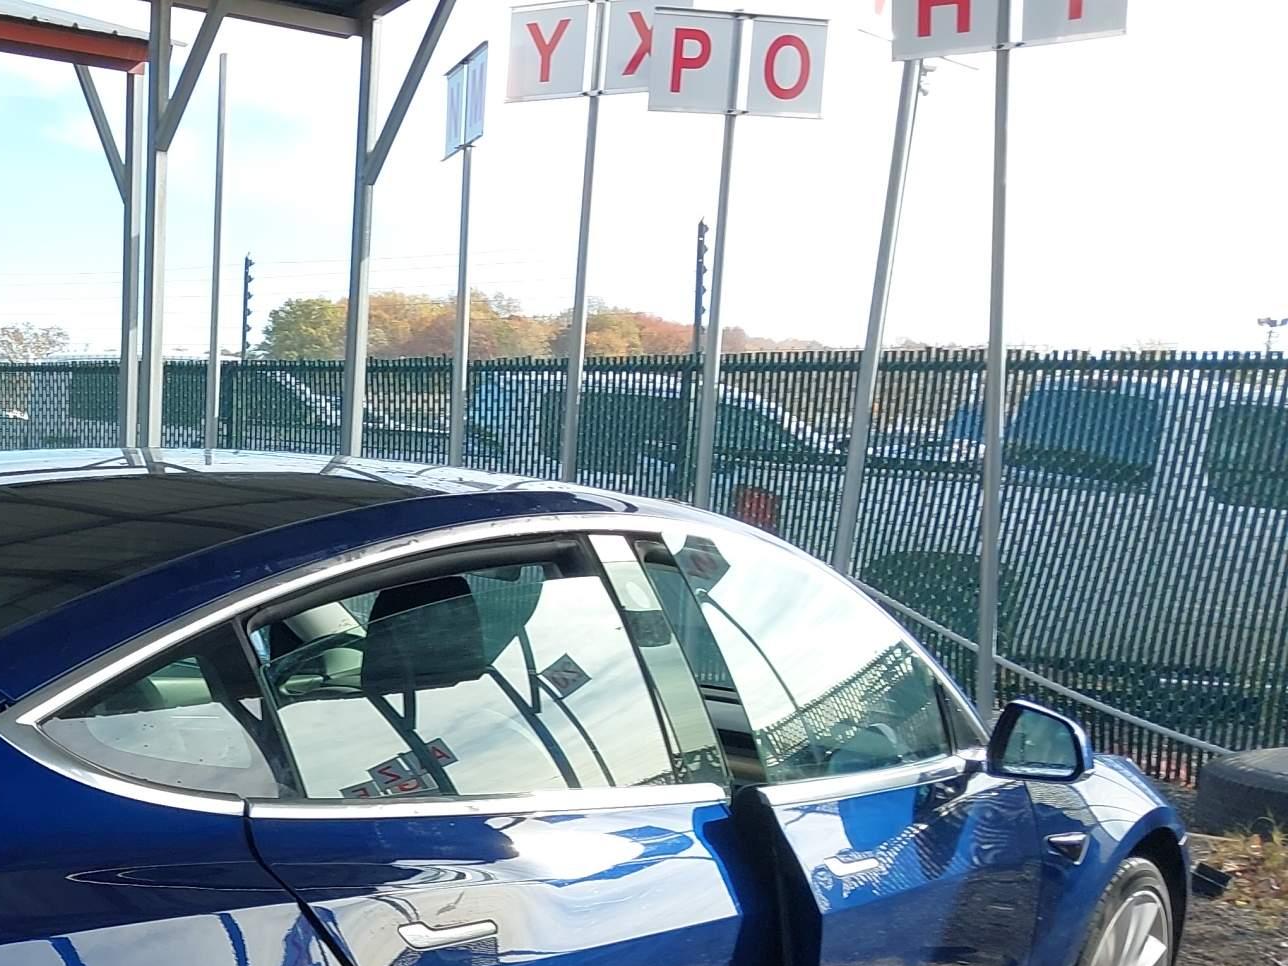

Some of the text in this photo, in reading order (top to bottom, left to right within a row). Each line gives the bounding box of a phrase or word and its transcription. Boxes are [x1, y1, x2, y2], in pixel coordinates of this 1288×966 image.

[525, 18, 572, 83] Y
[669, 27, 811, 100] P O
